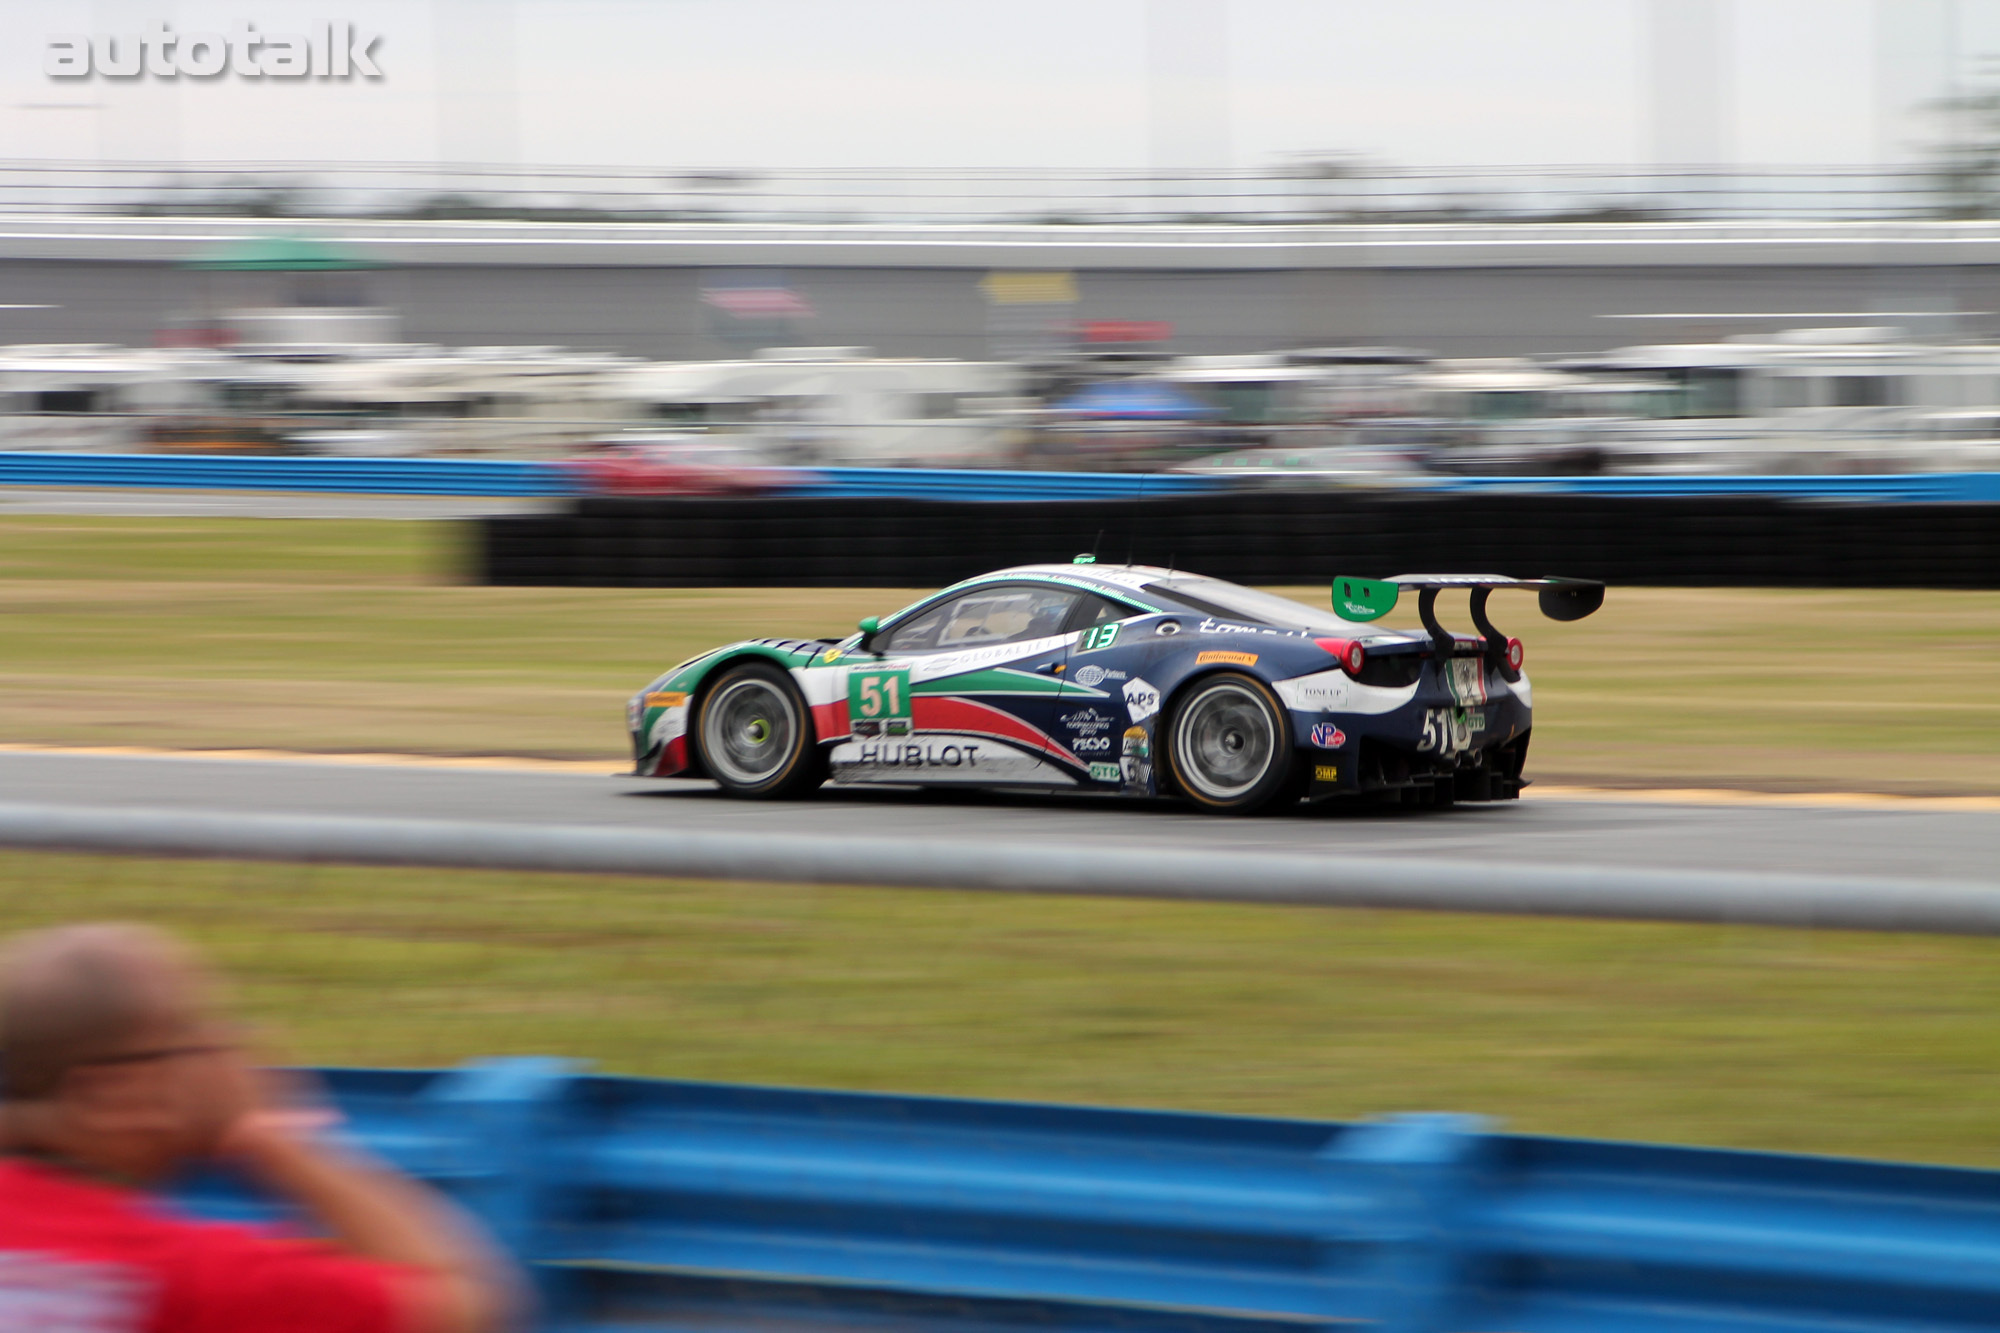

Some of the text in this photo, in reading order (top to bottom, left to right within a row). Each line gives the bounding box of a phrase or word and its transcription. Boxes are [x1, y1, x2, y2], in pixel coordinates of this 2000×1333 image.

[1086, 622, 1120, 650] 13
[859, 675, 900, 717] 51
[1126, 692, 1155, 706] APS
[1304, 687, 1326, 697] TONE
[1312, 722, 1337, 748] VP
[1416, 708, 1448, 755] 51
[860, 743, 979, 767] HUBLOT
[1090, 764, 1120, 778] GTD
[1315, 766, 1337, 780] OMP
